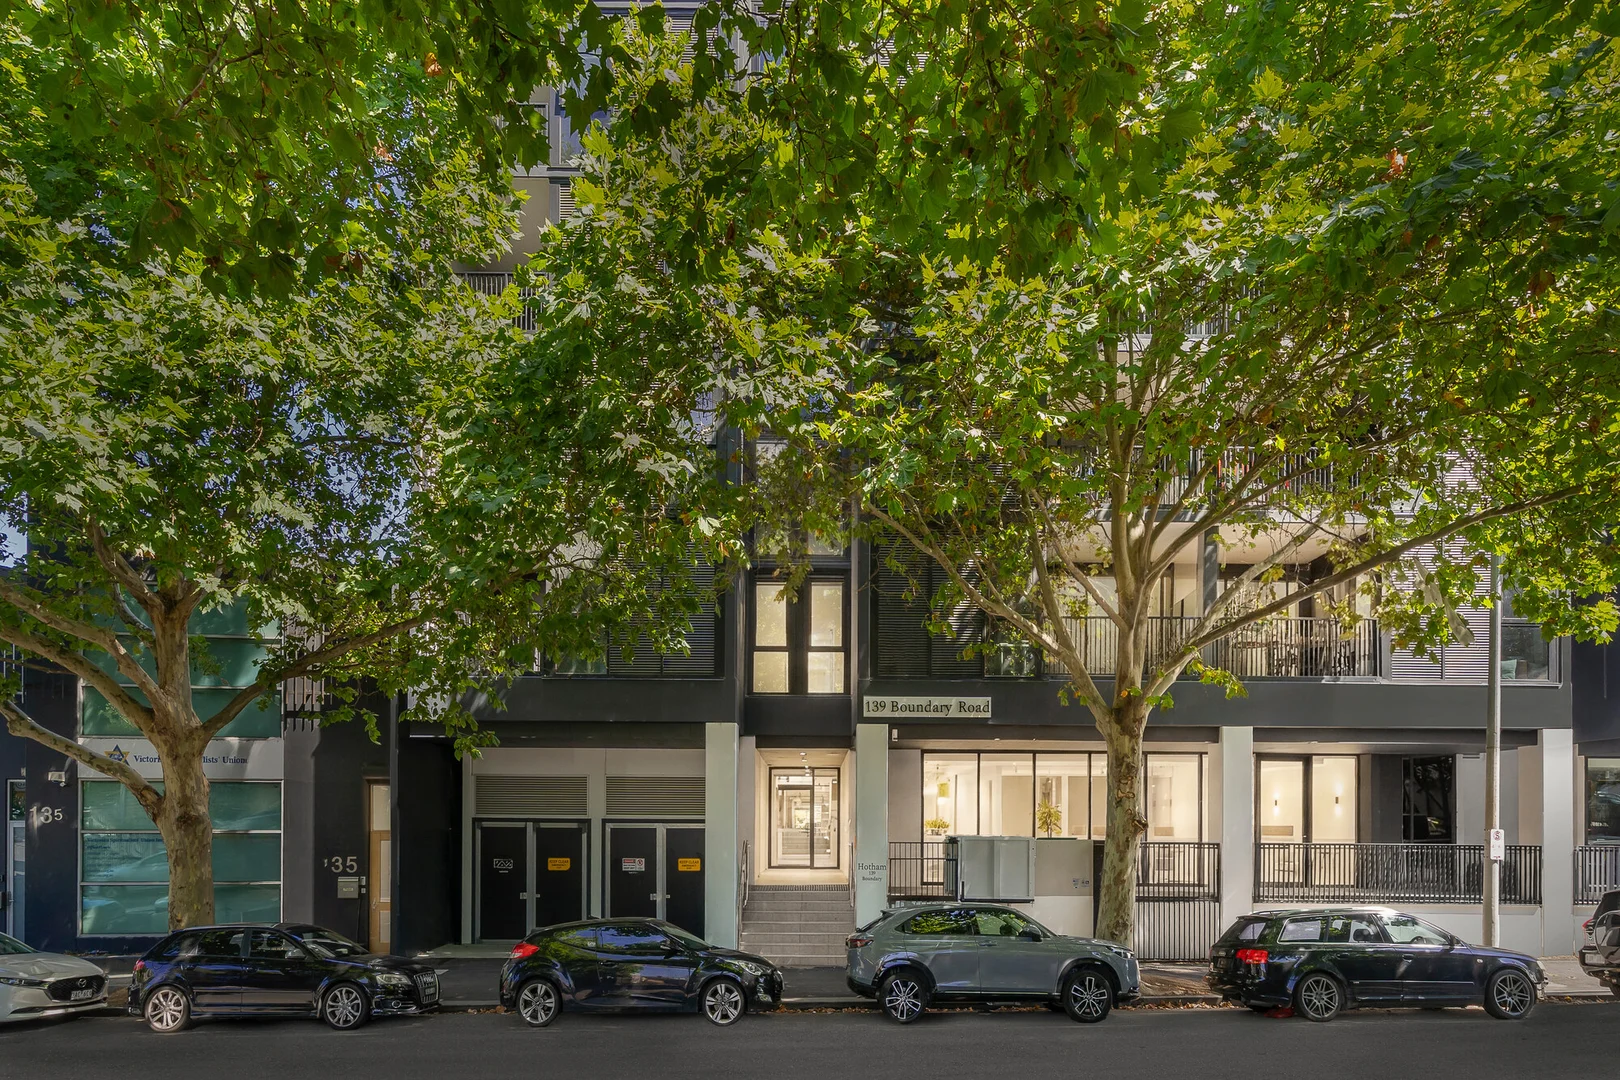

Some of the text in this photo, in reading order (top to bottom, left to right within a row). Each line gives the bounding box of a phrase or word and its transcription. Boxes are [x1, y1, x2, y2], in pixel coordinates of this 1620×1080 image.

[865, 700, 990, 717] 139 Boundary Road
[133, 754, 161, 764] Victori
[30, 806, 63, 825] 135
[857, 862, 887, 871] Hotham
